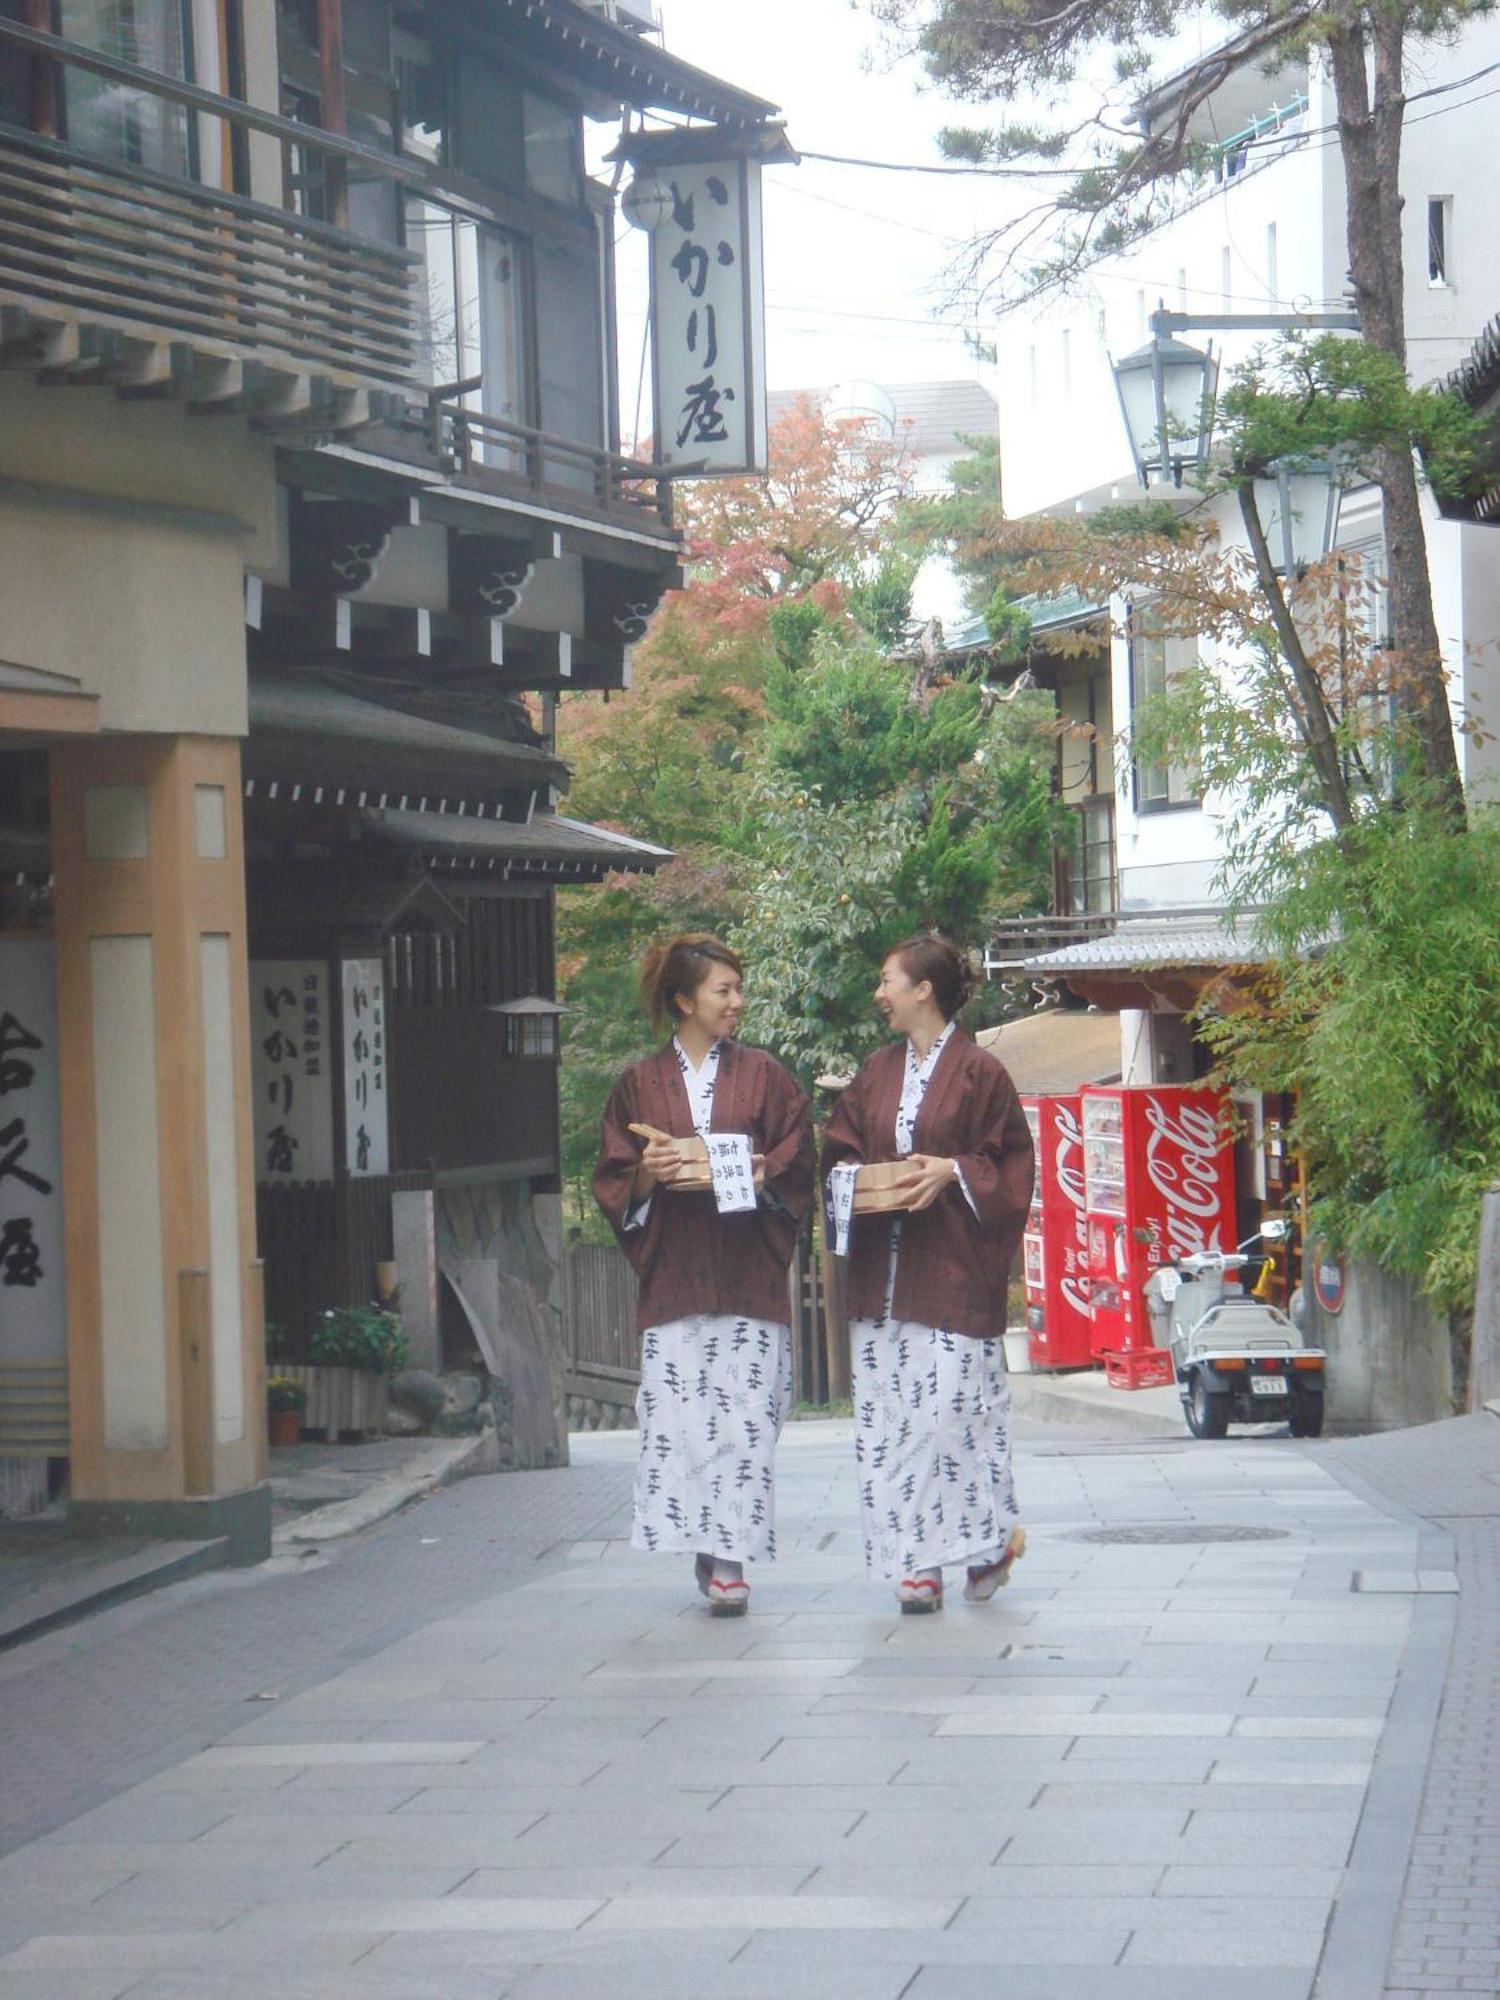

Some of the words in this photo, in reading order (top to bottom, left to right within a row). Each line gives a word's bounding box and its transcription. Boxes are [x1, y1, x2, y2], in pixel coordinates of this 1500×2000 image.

[670, 175, 734, 449] いかり屋
[263, 985, 299, 1173] いかり屋
[353, 985, 372, 1171] いかり屋
